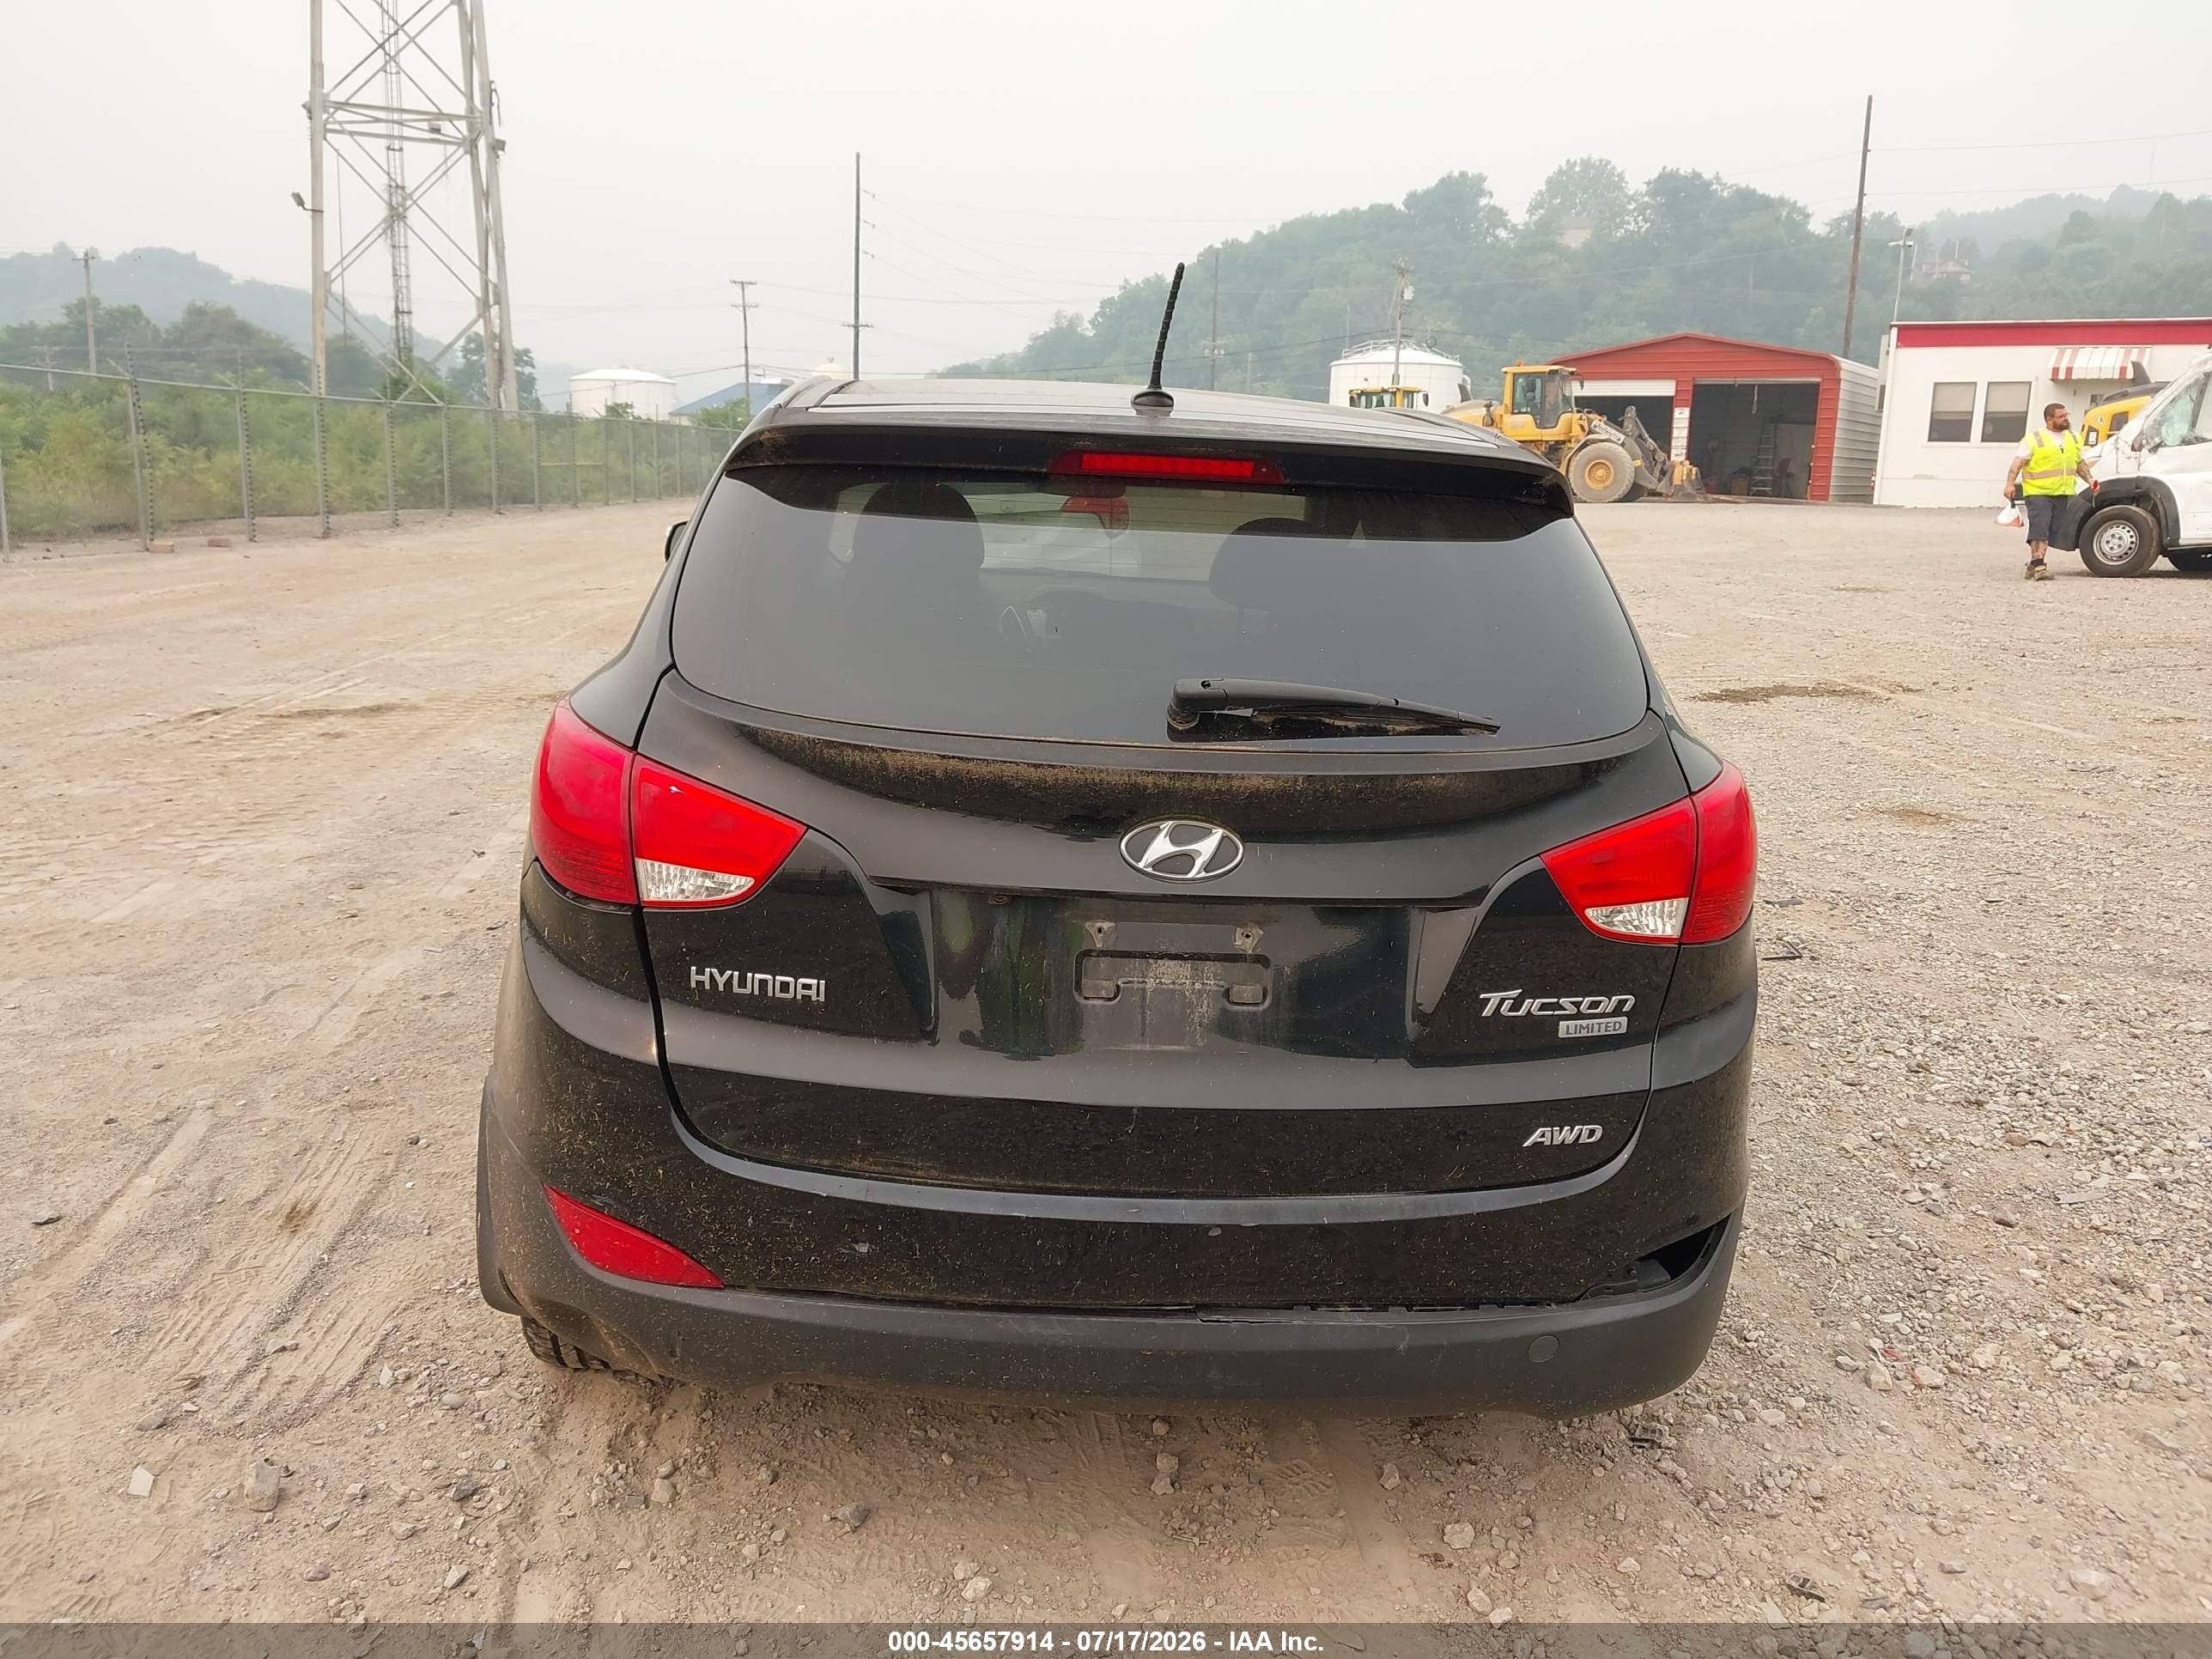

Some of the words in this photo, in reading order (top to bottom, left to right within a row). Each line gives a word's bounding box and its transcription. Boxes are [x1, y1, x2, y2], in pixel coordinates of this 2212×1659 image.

[690, 965, 826, 1003] HYUNDAI
[1565, 1020, 1623, 1036] LIMITED
[1522, 1124, 1603, 1147] AWD
